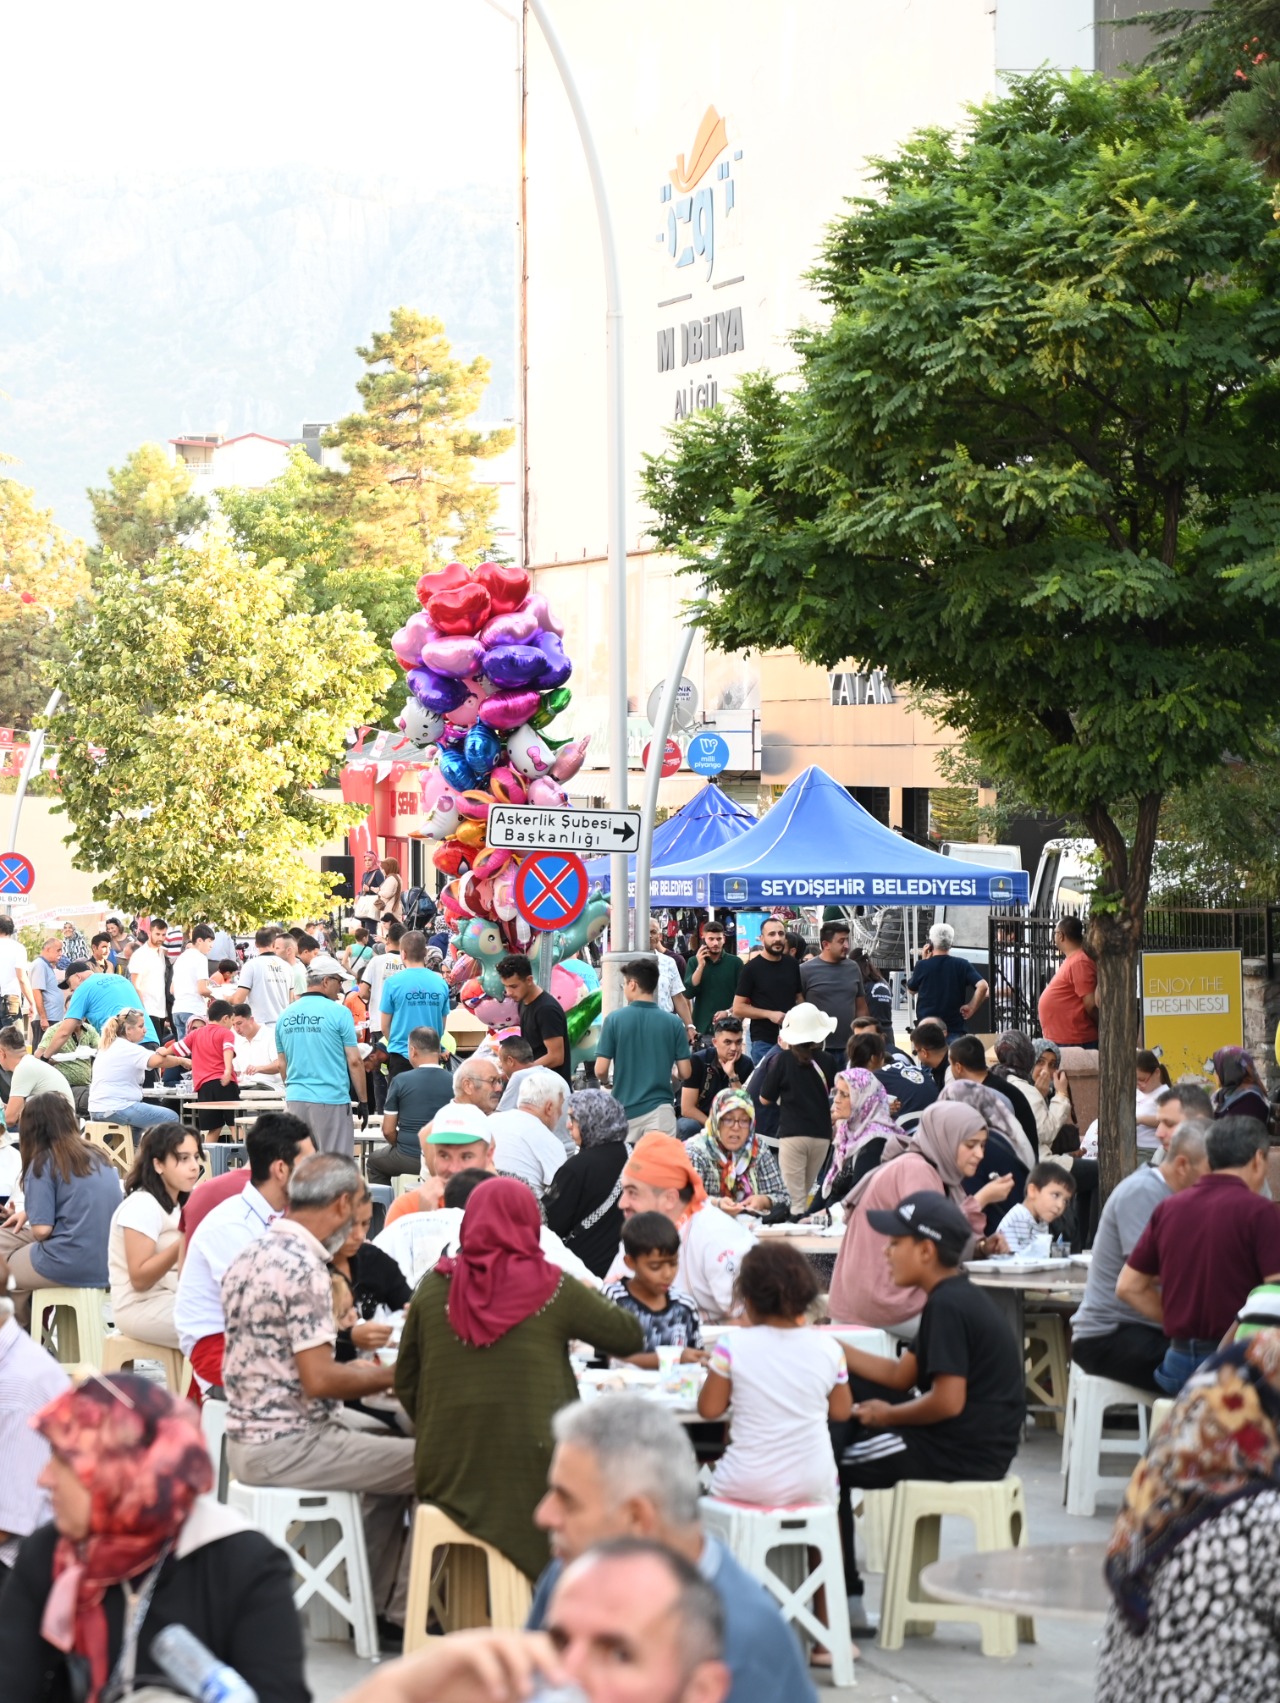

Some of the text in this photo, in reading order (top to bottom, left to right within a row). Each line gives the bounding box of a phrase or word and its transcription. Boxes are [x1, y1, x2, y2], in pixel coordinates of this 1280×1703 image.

[694, 760, 722, 769] piyango
[495, 811, 612, 830] Askerlik Şubesi
[504, 828, 600, 848] Başkanlığı
[660, 880, 694, 896] BELEDİYESİ
[761, 879, 976, 898] SEYDİŞEHİR BELEDİYESİ
[1149, 976, 1224, 995] ENJOY THE
[1150, 997, 1225, 1013] FRESHNESS!
